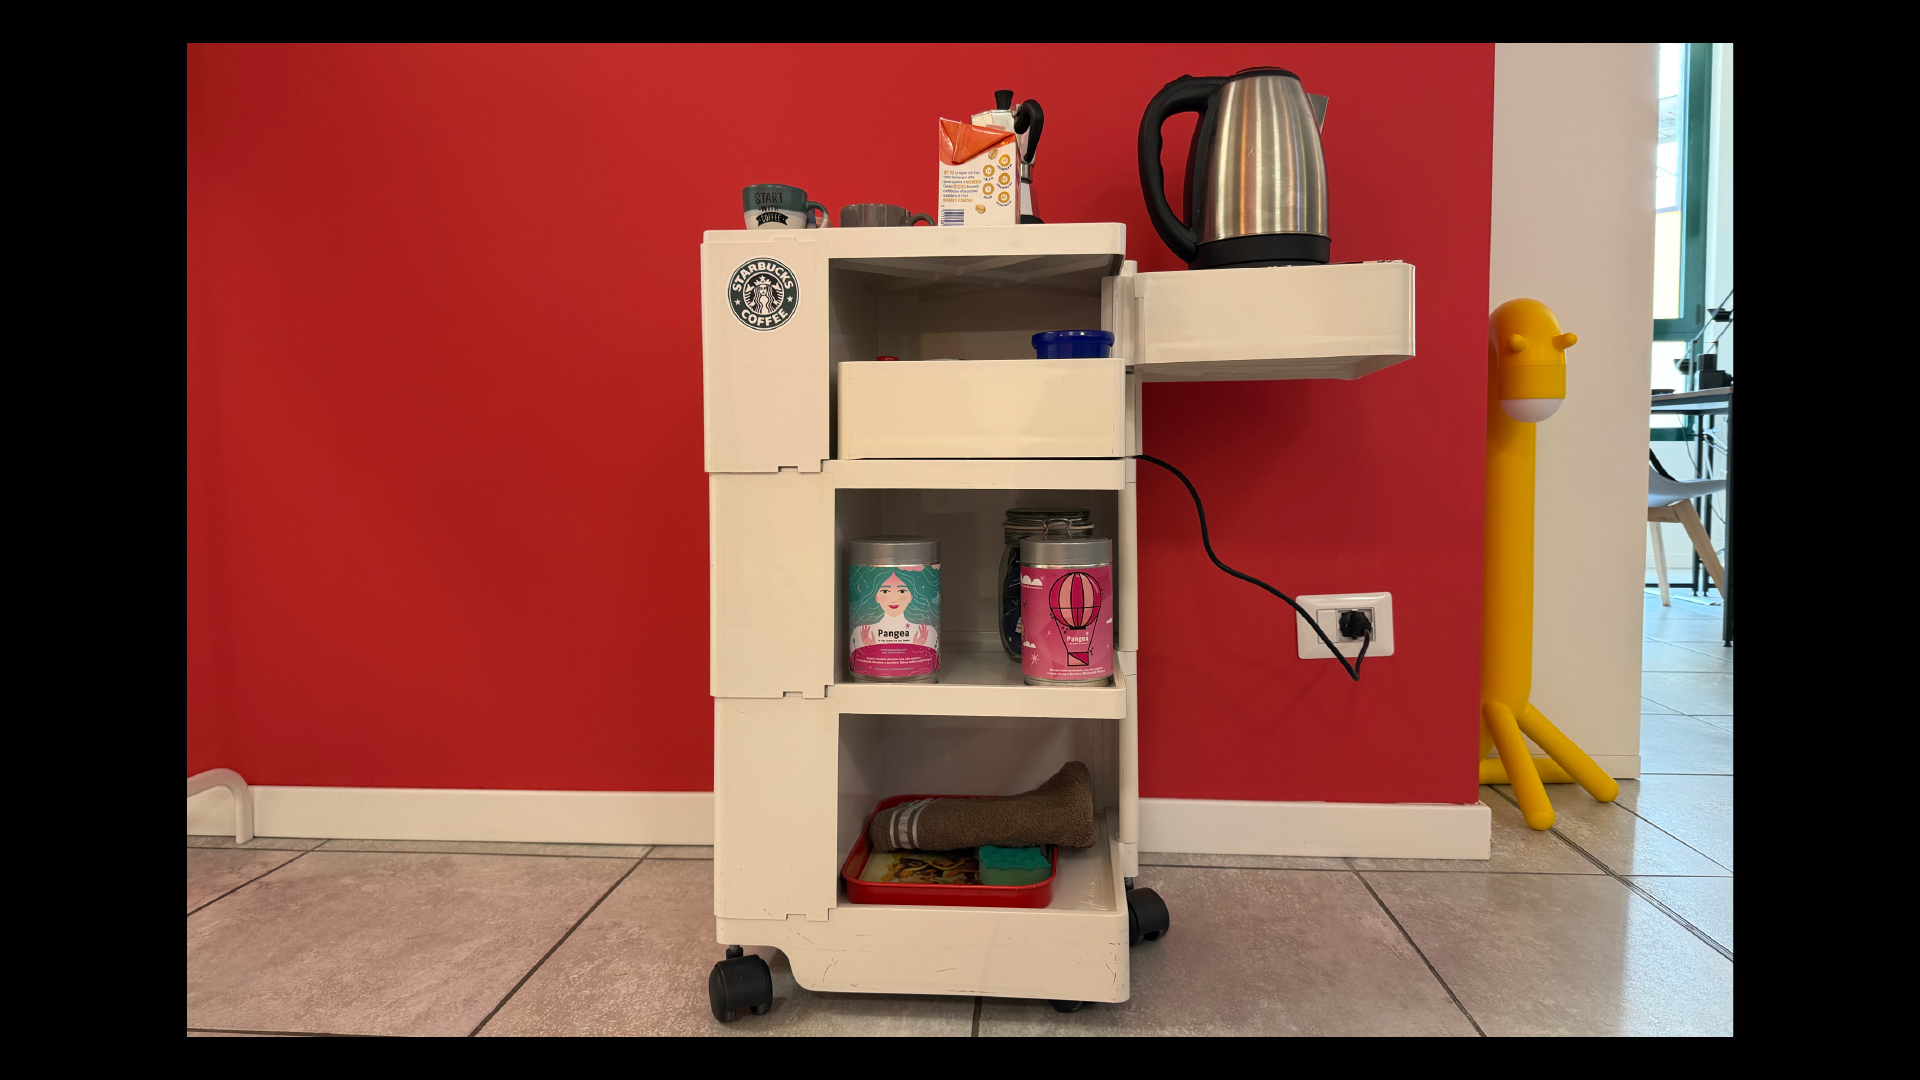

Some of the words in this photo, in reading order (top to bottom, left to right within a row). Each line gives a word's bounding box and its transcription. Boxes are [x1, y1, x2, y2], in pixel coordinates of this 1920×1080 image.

[754, 191, 783, 205] START
[760, 213, 782, 223] COFFEE
[732, 261, 794, 292] STARBUCKS
[741, 308, 789, 327] COFFEE
[877, 629, 910, 639] Pangea
[1066, 635, 1089, 643] Pangea
